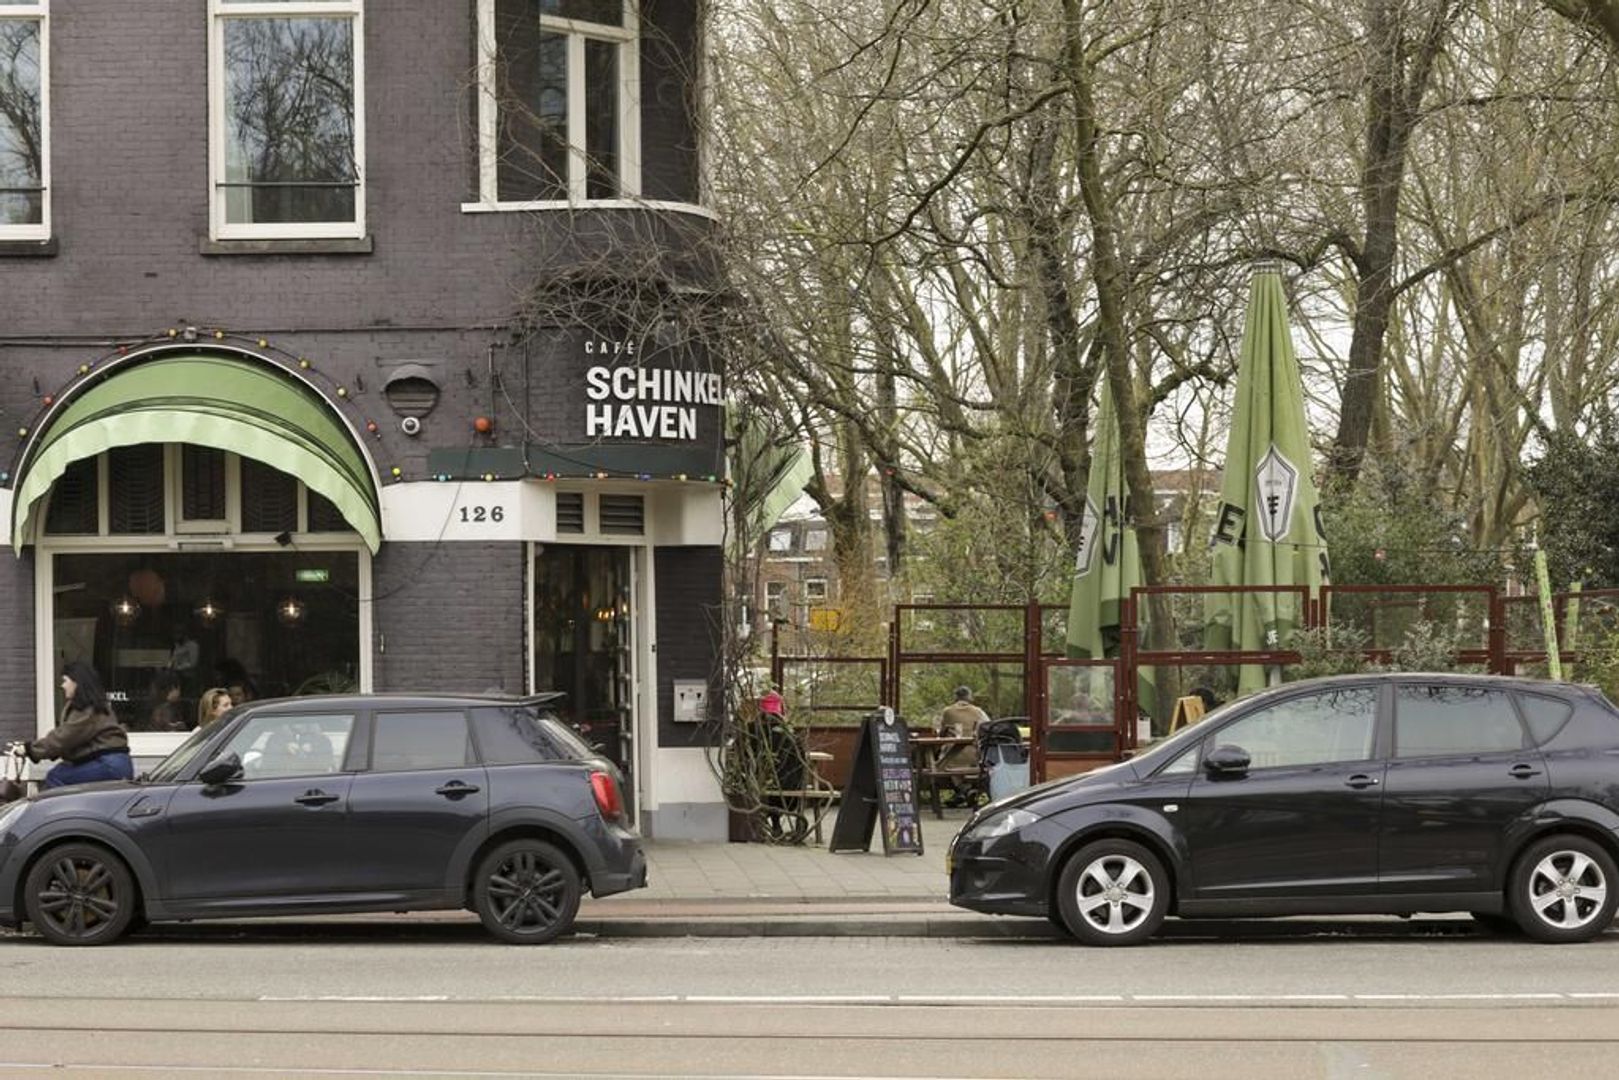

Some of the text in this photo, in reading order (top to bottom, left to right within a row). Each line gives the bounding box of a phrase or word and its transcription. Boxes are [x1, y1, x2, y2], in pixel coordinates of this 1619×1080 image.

[584, 340, 635, 355] CAFÉ
[586, 366, 727, 406] SCHINKEL
[586, 404, 697, 440] HAVEN
[459, 505, 504, 523] 126
